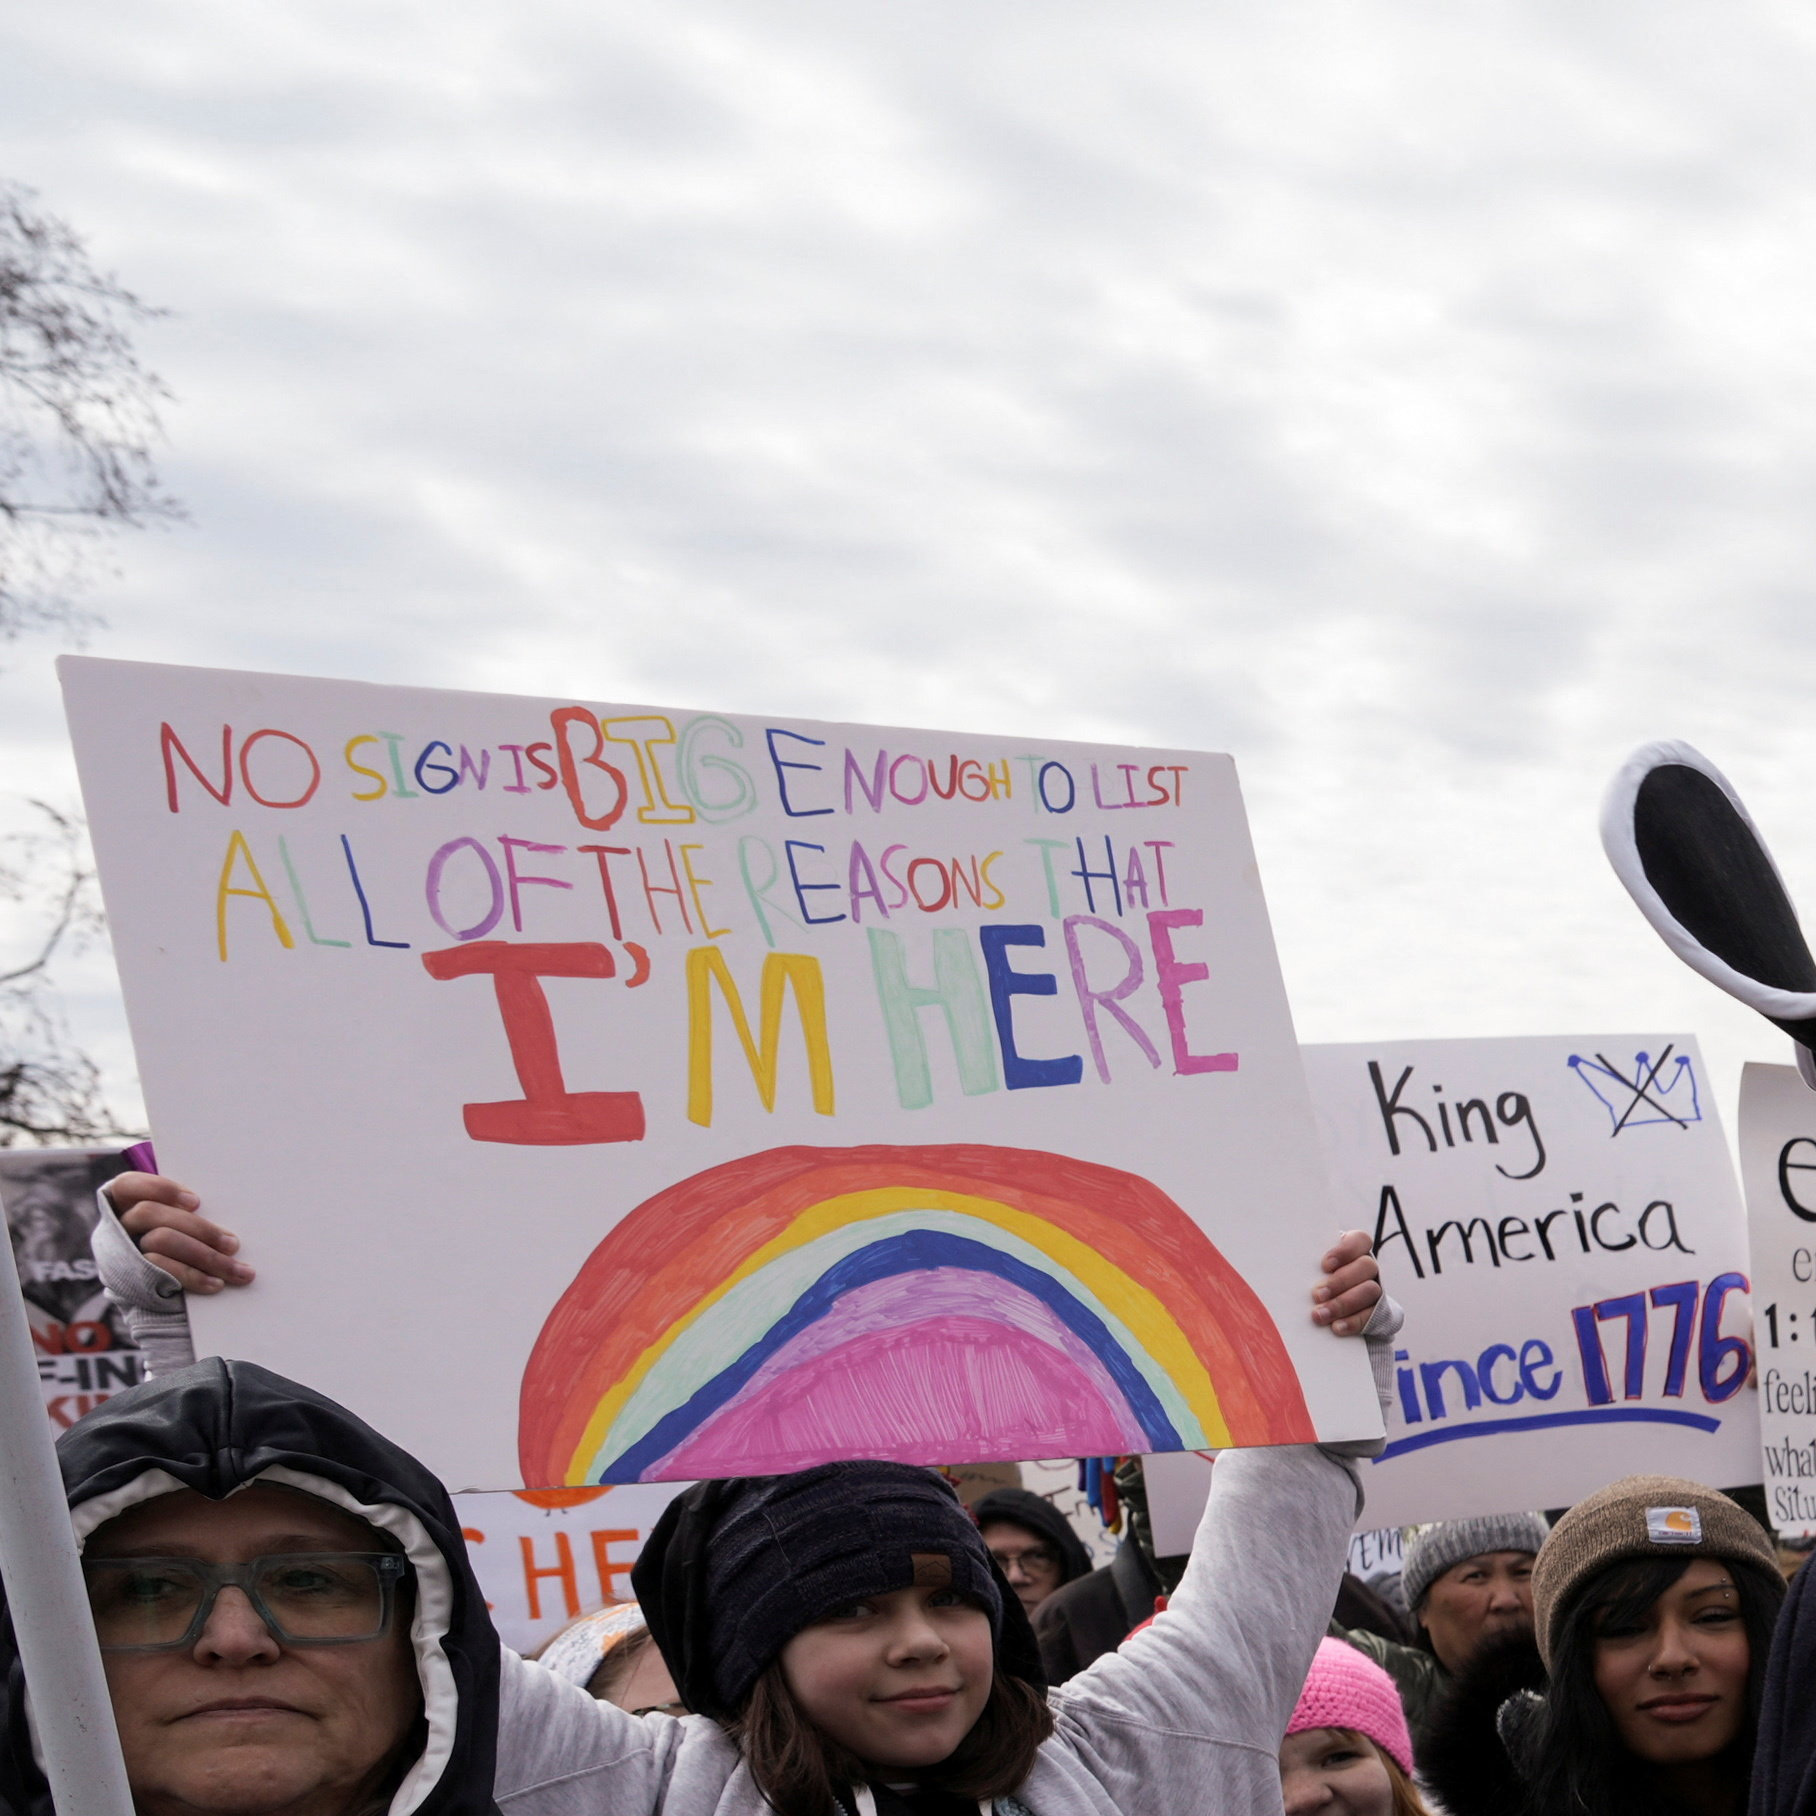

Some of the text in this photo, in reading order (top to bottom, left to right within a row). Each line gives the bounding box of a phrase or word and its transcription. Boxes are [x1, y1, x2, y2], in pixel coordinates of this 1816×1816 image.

[162, 706, 1189, 831] NO SIGN IS BIG ENOUGH TO LIST
[215, 828, 1177, 960] ALL OF THE REASONS THAT
[421, 909, 1239, 1144] I'M HERE
[1367, 1059, 1547, 1179] King
[1371, 1184, 1696, 1279] America
[1570, 1270, 1751, 1407] 1776
